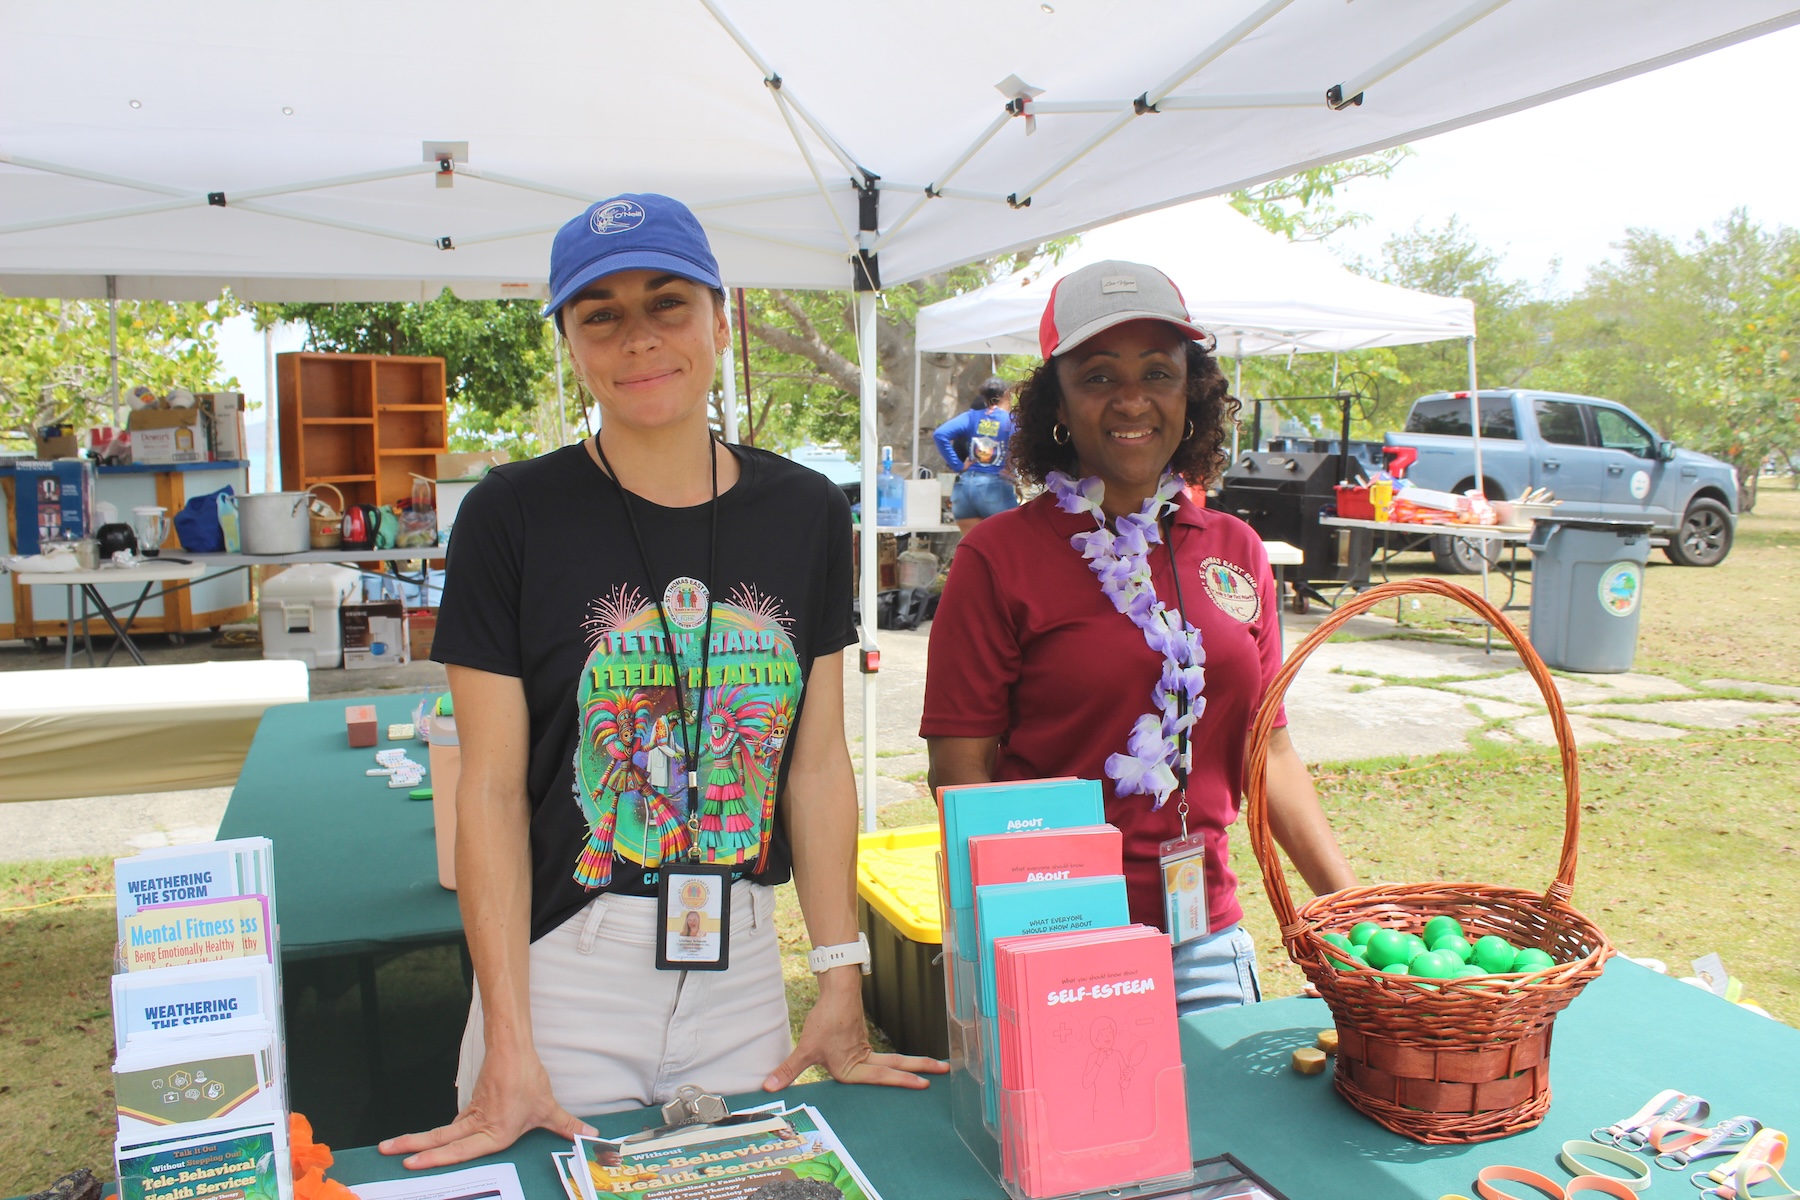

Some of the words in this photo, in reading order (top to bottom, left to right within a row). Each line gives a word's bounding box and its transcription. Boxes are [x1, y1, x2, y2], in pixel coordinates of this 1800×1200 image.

[1223, 560, 1245, 574] EAST
[1244, 573, 1258, 588] END
[668, 578, 688, 594] THOMAS
[690, 580, 704, 590] EAST
[709, 630, 783, 656] HARD,
[688, 662, 796, 688] HEALTHY
[1007, 818, 1043, 830] ABOUT
[128, 872, 212, 894] WEATHERING
[1026, 870, 1070, 882] ABOUT
[134, 892, 159, 906] THE
[163, 886, 208, 902] STORM
[1022, 927, 1048, 935] SHOULD
[1070, 920, 1092, 928] ABOUT
[1030, 918, 1049, 926] WHAT
[1051, 914, 1084, 924] EVERYONE
[131, 920, 182, 946] Mental
[186, 918, 235, 940] Fitness
[135, 950, 156, 964] Being
[158, 942, 203, 959] Emotionally
[205, 938, 235, 954] Healthy
[1047, 978, 1155, 1006] SELF-ESTEEM
[145, 998, 238, 1020] WEATHERING
[152, 1161, 186, 1174] Without
[186, 1154, 224, 1166] Stepping
[225, 1150, 242, 1158] Out!
[173, 1150, 192, 1159] Talk
[602, 1134, 808, 1178] Tele-Behavioral
[632, 1148, 682, 1160] Without
[142, 1158, 256, 1191] Tele-Behavioral
[610, 1170, 700, 1192] Health
[704, 1150, 816, 1178] Services
[718, 1176, 746, 1186] Family
[747, 1170, 782, 1180] Therapy
[196, 1174, 256, 1196] Services
[682, 1190, 703, 1198] Teen
[705, 1184, 740, 1194] Therapy
[710, 1190, 742, 1200] Anxiety
